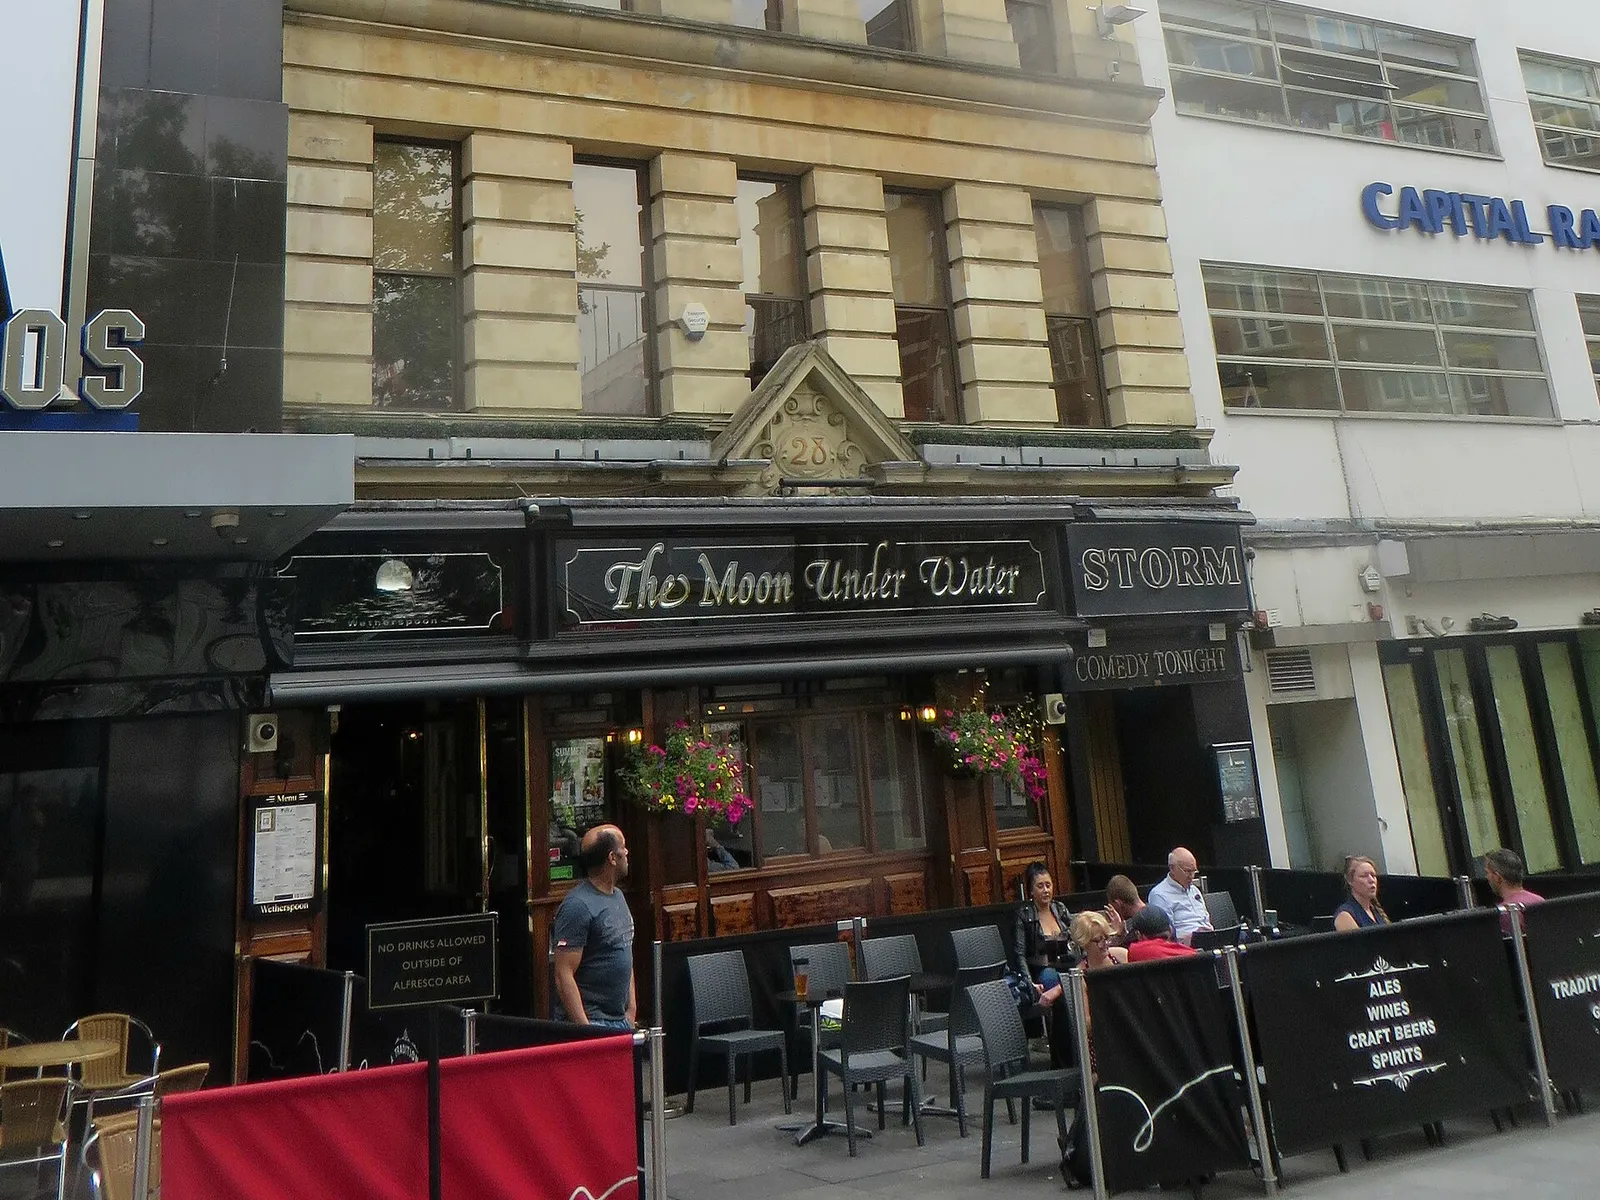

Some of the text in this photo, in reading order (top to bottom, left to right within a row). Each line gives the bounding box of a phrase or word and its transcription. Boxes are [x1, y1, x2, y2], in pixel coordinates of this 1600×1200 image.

[1361, 181, 1543, 245] CAPITAL
[790, 436, 828, 466] 28
[604, 541, 1020, 611] The Moon Under Water
[1082, 546, 1242, 591] STORM
[347, 618, 438, 628] Wetherspoon
[1075, 648, 1226, 682] COMEDY TONIGHT
[276, 795, 297, 803] Menu
[260, 902, 309, 914] Wetherspoon
[378, 934, 486, 954] NO DRINKS ALLOWED
[402, 956, 462, 971] OUTSIDE OF
[393, 975, 471, 991] ALFRESCO AREA
[1369, 979, 1402, 998] ALES
[1366, 1001, 1410, 1021] WINES
[1349, 1019, 1437, 1049] CRAFT BEERS
[1371, 1046, 1423, 1070] SPIRITS
